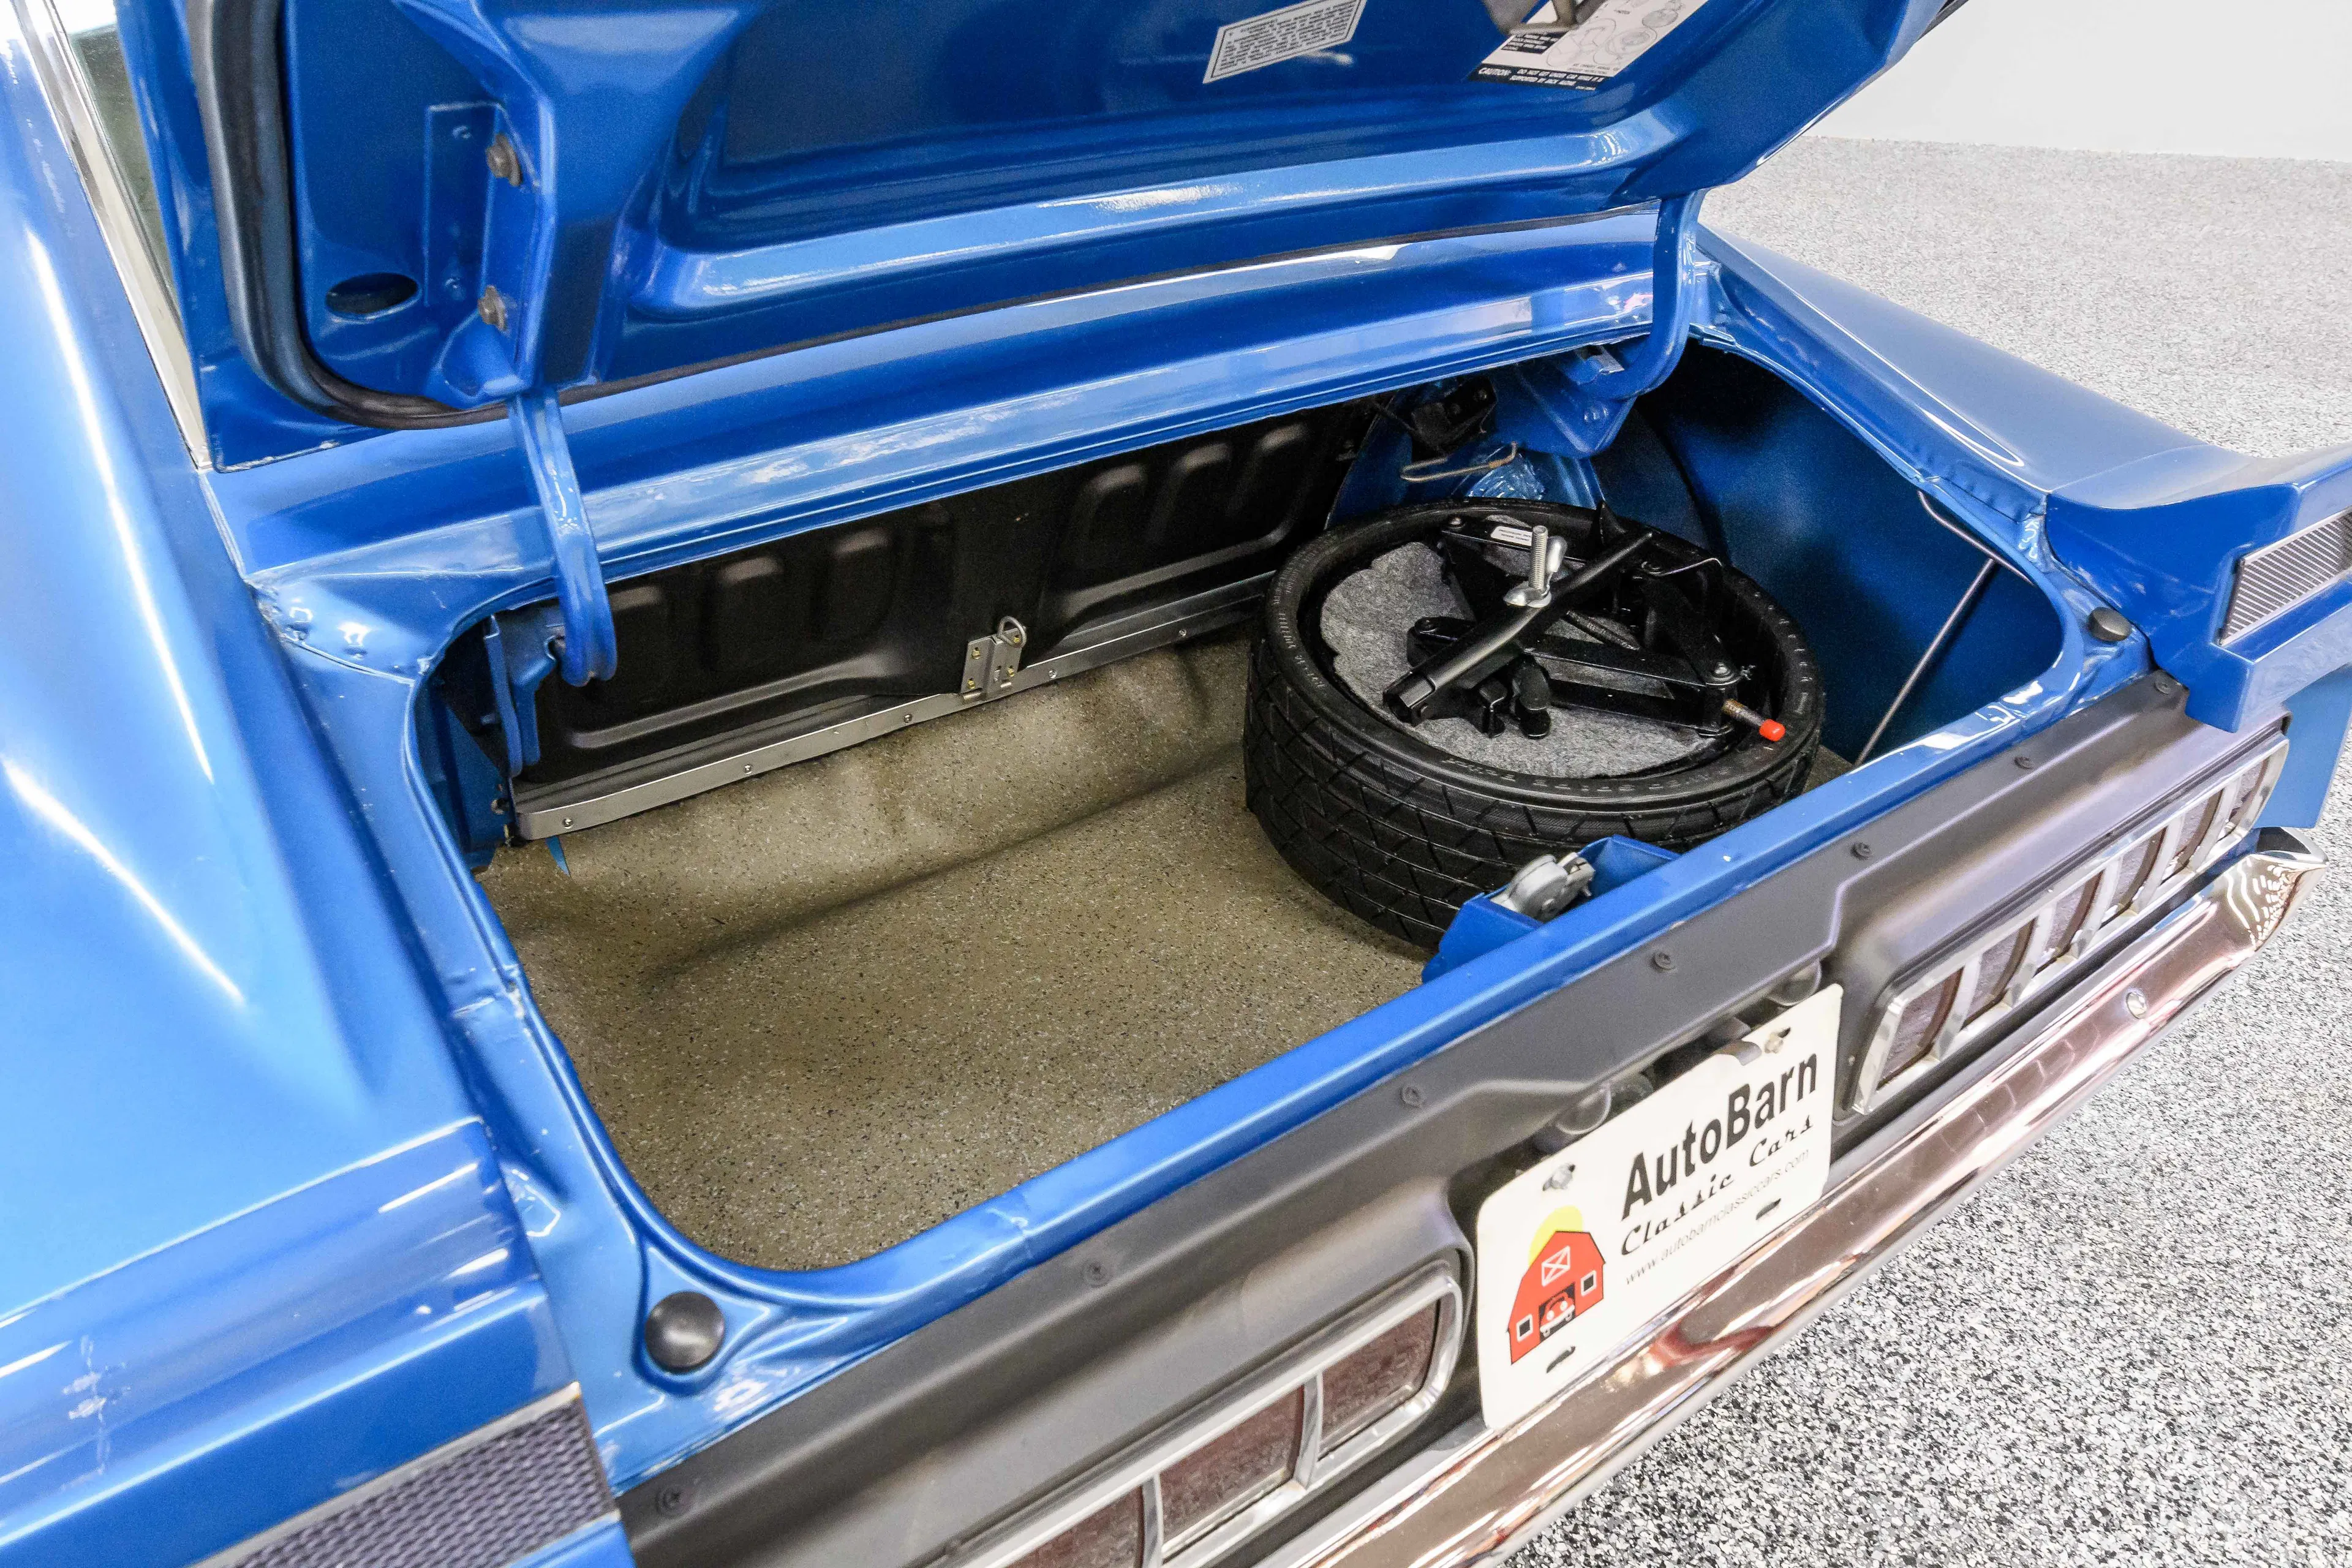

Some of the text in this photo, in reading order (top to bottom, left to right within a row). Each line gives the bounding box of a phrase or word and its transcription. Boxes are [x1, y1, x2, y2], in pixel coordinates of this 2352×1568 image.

[1621, 1054, 1817, 1221] AutoBarn
[1621, 1115, 1813, 1256] Classic Cars
[1626, 1149, 1809, 1285] www.autobarnclassiccars.com
